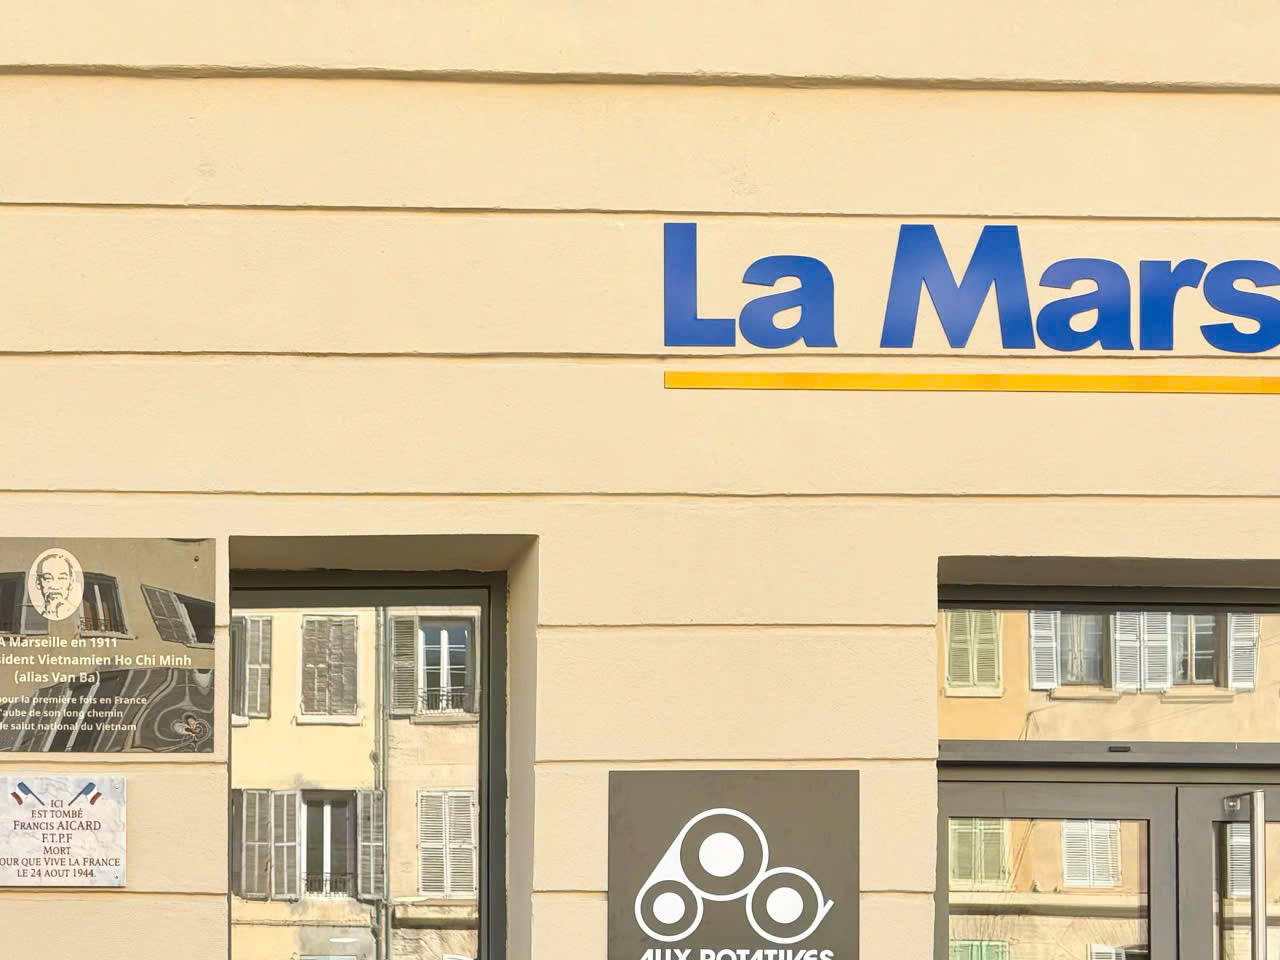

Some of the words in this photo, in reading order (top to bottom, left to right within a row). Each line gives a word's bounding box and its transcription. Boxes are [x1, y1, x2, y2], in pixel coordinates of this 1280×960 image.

[663, 222, 838, 349] La
[880, 224, 1280, 353] Mars
[9, 636, 68, 648] Marseille
[71, 639, 86, 648] en
[89, 637, 118, 648] 1911
[37, 654, 112, 666] Vietnamien
[115, 655, 132, 666] Ho
[135, 654, 156, 666] Chi
[159, 654, 191, 666] Minh
[14, 671, 49, 684] (alias
[51, 672, 76, 683] Van
[79, 671, 101, 685] Ba)
[20, 695, 31, 704] la
[32, 694, 77, 707] première
[79, 695, 97, 705] fois
[100, 697, 111, 705] en
[115, 696, 147, 705] France
[29, 708, 42, 718] de
[45, 710, 61, 718] son
[63, 709, 85, 720] long
[87, 709, 123, 718] chemin
[0, 721, 8, 731] le
[11, 722, 35, 731] salut
[37, 722, 78, 731] national
[80, 722, 93, 731] du
[95, 722, 137, 731] Vietnam
[50, 800, 63, 808] ICI
[31, 810, 48, 818] EST
[49, 808, 83, 818] TOMBÉ
[56, 820, 102, 830] AICARD
[43, 846, 71, 855] MORT
[21, 857, 42, 867] QUE
[43, 857, 66, 866] VIVE
[68, 858, 80, 866] LA
[83, 857, 120, 867] FRANCE
[17, 869, 28, 877] LE
[30, 868, 42, 877] 24
[44, 869, 70, 877] AOUT
